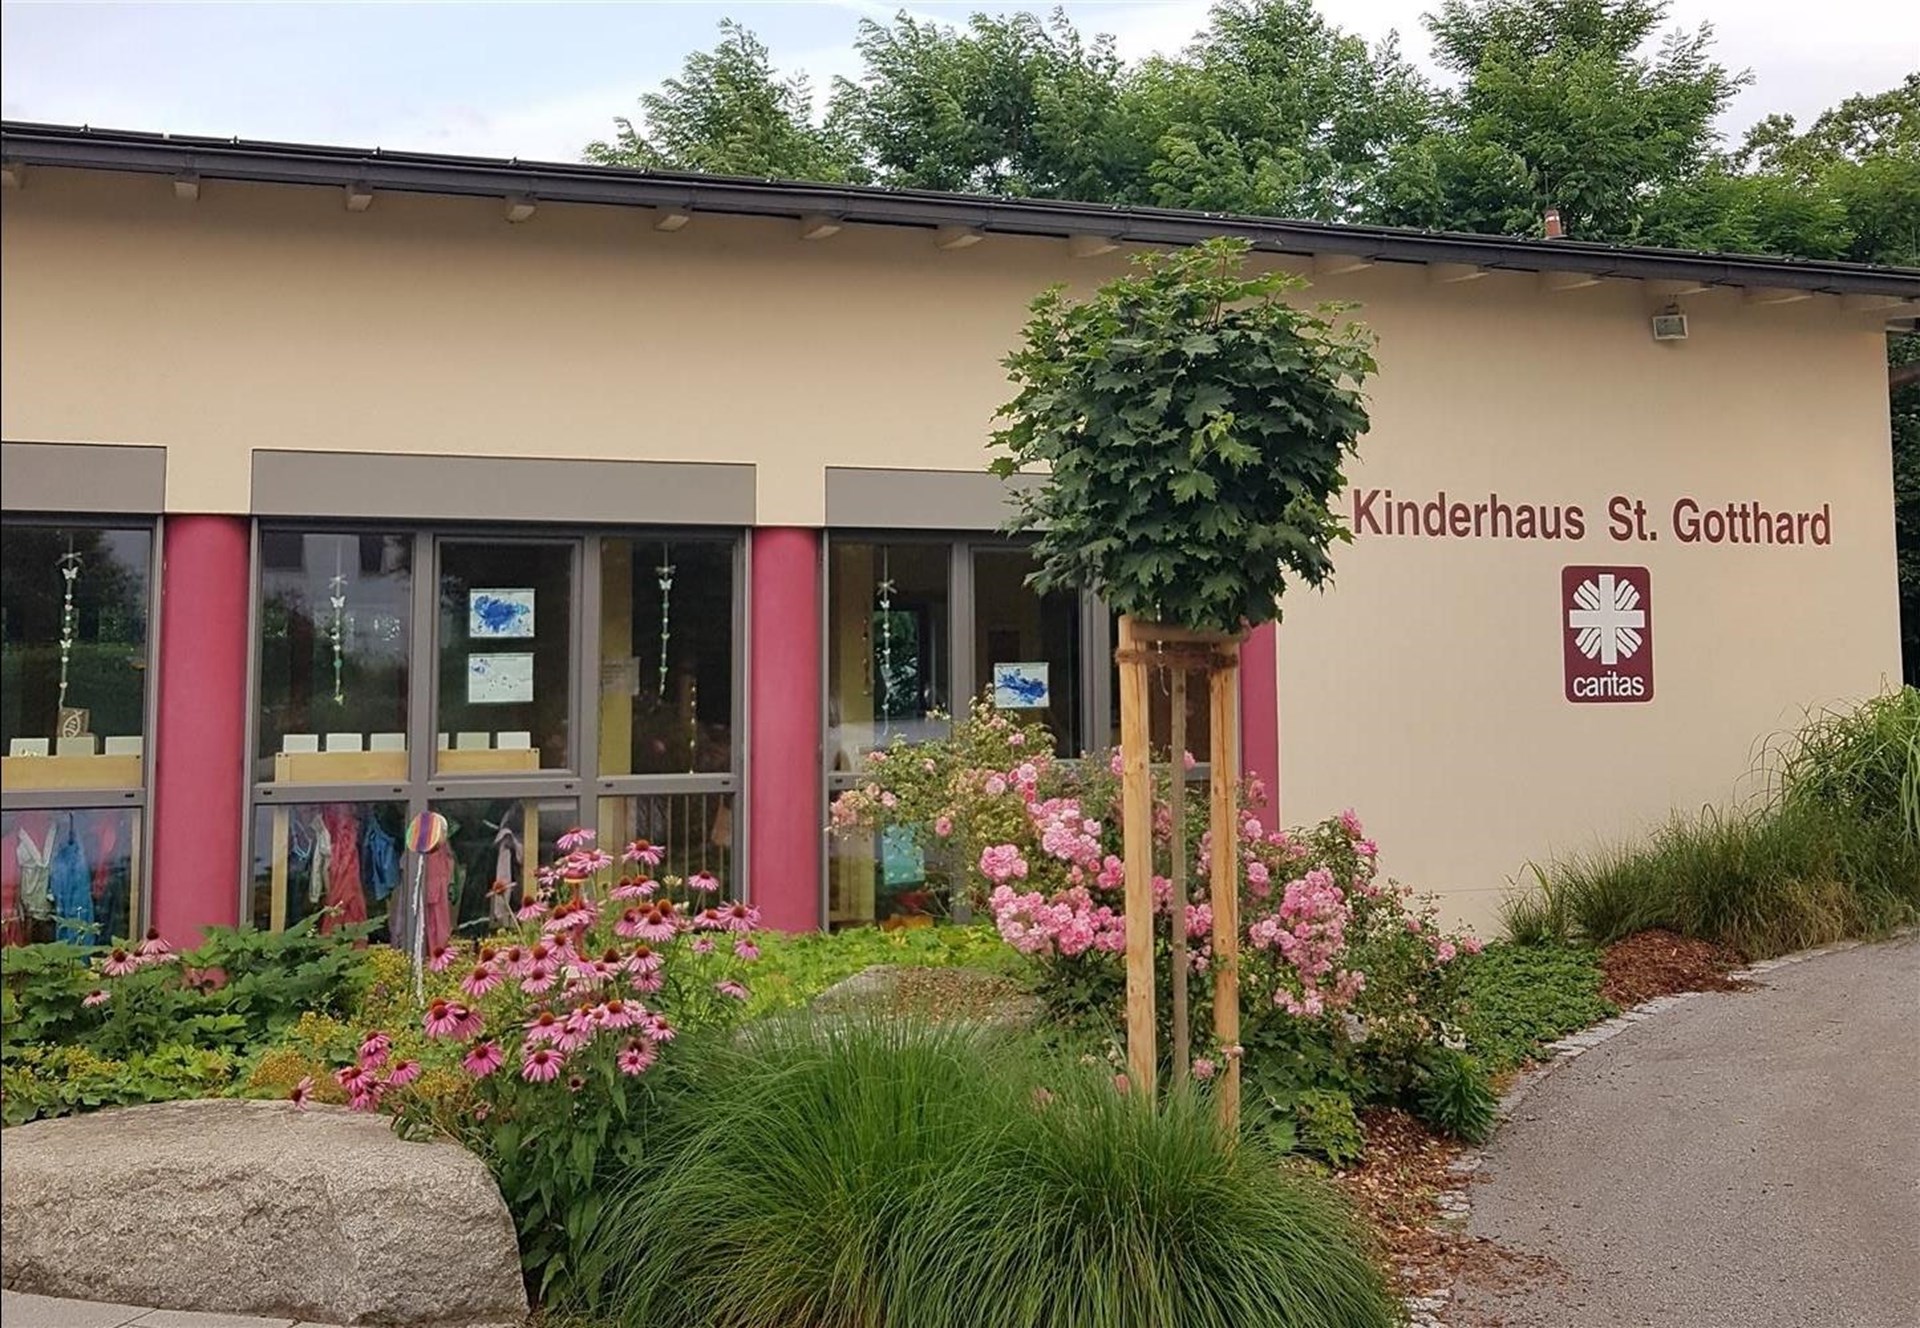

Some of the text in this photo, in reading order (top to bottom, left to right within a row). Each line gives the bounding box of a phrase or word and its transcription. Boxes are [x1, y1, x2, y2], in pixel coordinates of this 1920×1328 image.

[1353, 489, 1831, 545] Kinderhaus St. Gotthard
[1573, 671, 1645, 698] caritas
